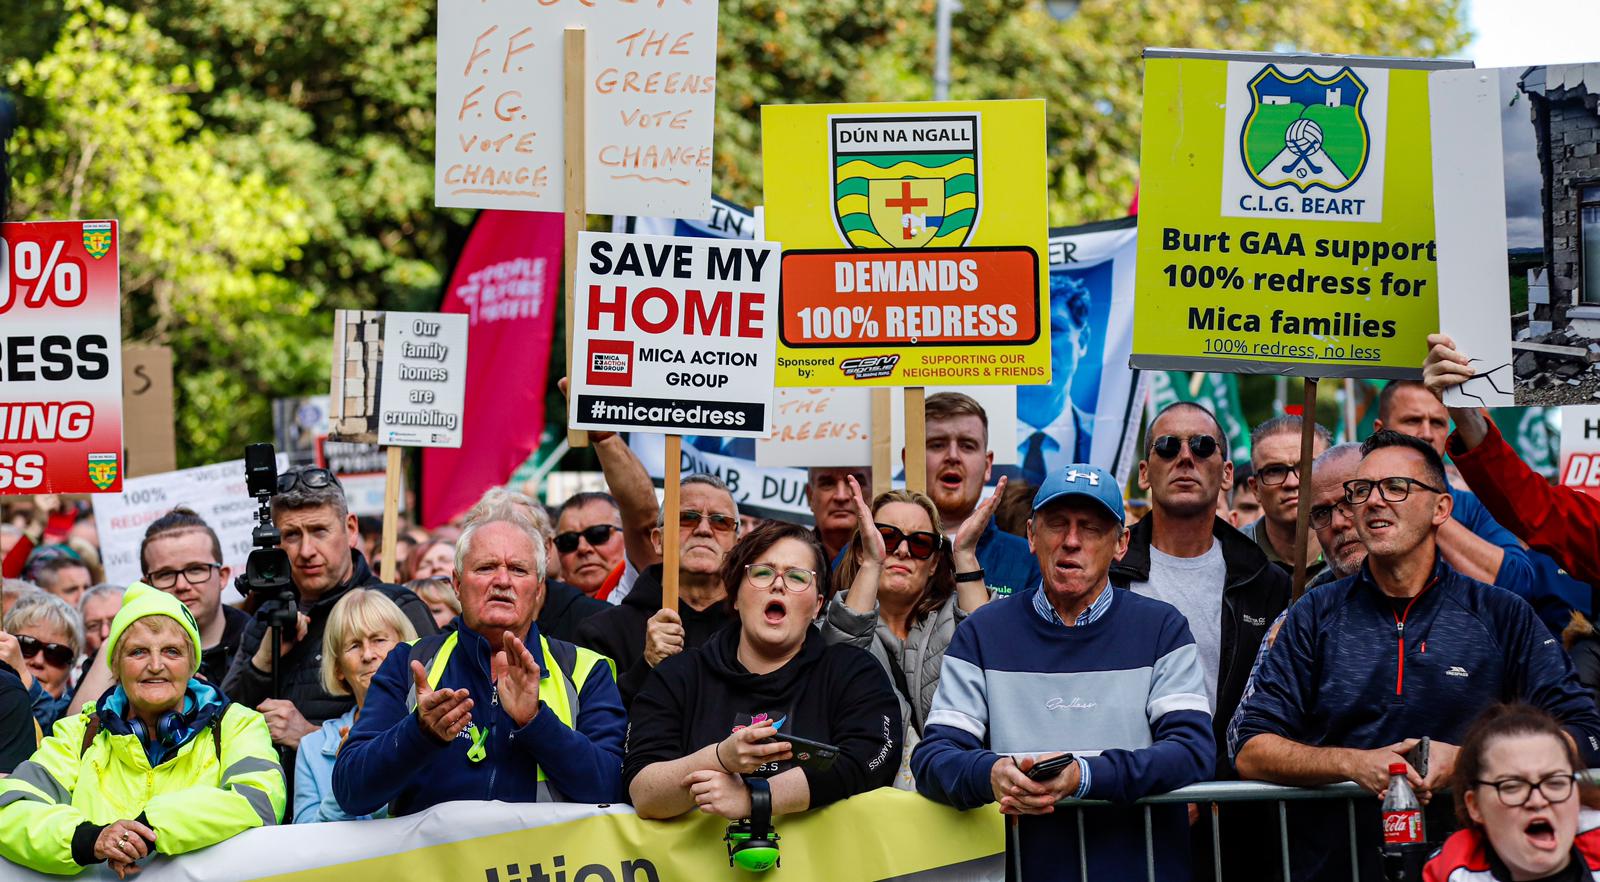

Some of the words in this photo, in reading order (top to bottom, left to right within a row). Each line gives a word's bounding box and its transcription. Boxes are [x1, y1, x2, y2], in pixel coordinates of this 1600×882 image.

[464, 25, 535, 76] F.F.
[617, 28, 694, 56] THE
[595, 68, 715, 94] GREENS
[458, 85, 527, 121] F.G.
[621, 109, 692, 129] VOTE
[459, 132, 536, 152] VOTE
[839, 127, 878, 144] DÚN
[883, 130, 908, 143] NA
[912, 128, 971, 142] NGALL
[600, 145, 711, 168] CHANGE
[444, 164, 548, 186] CHANGE
[1239, 195, 1294, 213] C.L.G.
[1301, 197, 1365, 215] BEART
[1162, 227, 1230, 253] Burt
[1239, 231, 1306, 256] GAA
[1315, 237, 1437, 266] support
[589, 240, 693, 279] SAVE
[707, 246, 771, 282] MY
[835, 259, 978, 293] DEMANDS
[1163, 264, 1244, 289] 100%
[1253, 268, 1371, 294] redress
[1380, 271, 1427, 297] for
[587, 284, 765, 339] HOME
[797, 306, 879, 339] 100%
[886, 303, 1018, 338] REDRESS
[1188, 307, 1260, 333] Mica
[1270, 309, 1396, 338] families
[412, 319, 441, 337] Our
[0, 334, 110, 381] ESS
[402, 341, 448, 362] family
[638, 348, 685, 364] MICA
[690, 351, 758, 367] ACTION
[921, 354, 997, 364] SUPPORTING
[1000, 354, 1025, 364] OUR
[1204, 338, 1248, 353] 100%
[1253, 341, 1319, 360] redress,
[1323, 345, 1343, 359] no
[1350, 344, 1381, 360] less
[399, 363, 448, 382] homes
[777, 357, 835, 368] Sponsored
[798, 368, 815, 378] by:
[903, 367, 980, 377] NEIGHBOURS
[983, 367, 991, 377] &
[994, 366, 1045, 377] FRIENDS
[666, 372, 729, 388] GROUP
[409, 386, 435, 404] are
[591, 400, 746, 426] #micaredress
[780, 398, 831, 415] THE
[383, 408, 458, 431] crumbling
[762, 475, 809, 507] DU
